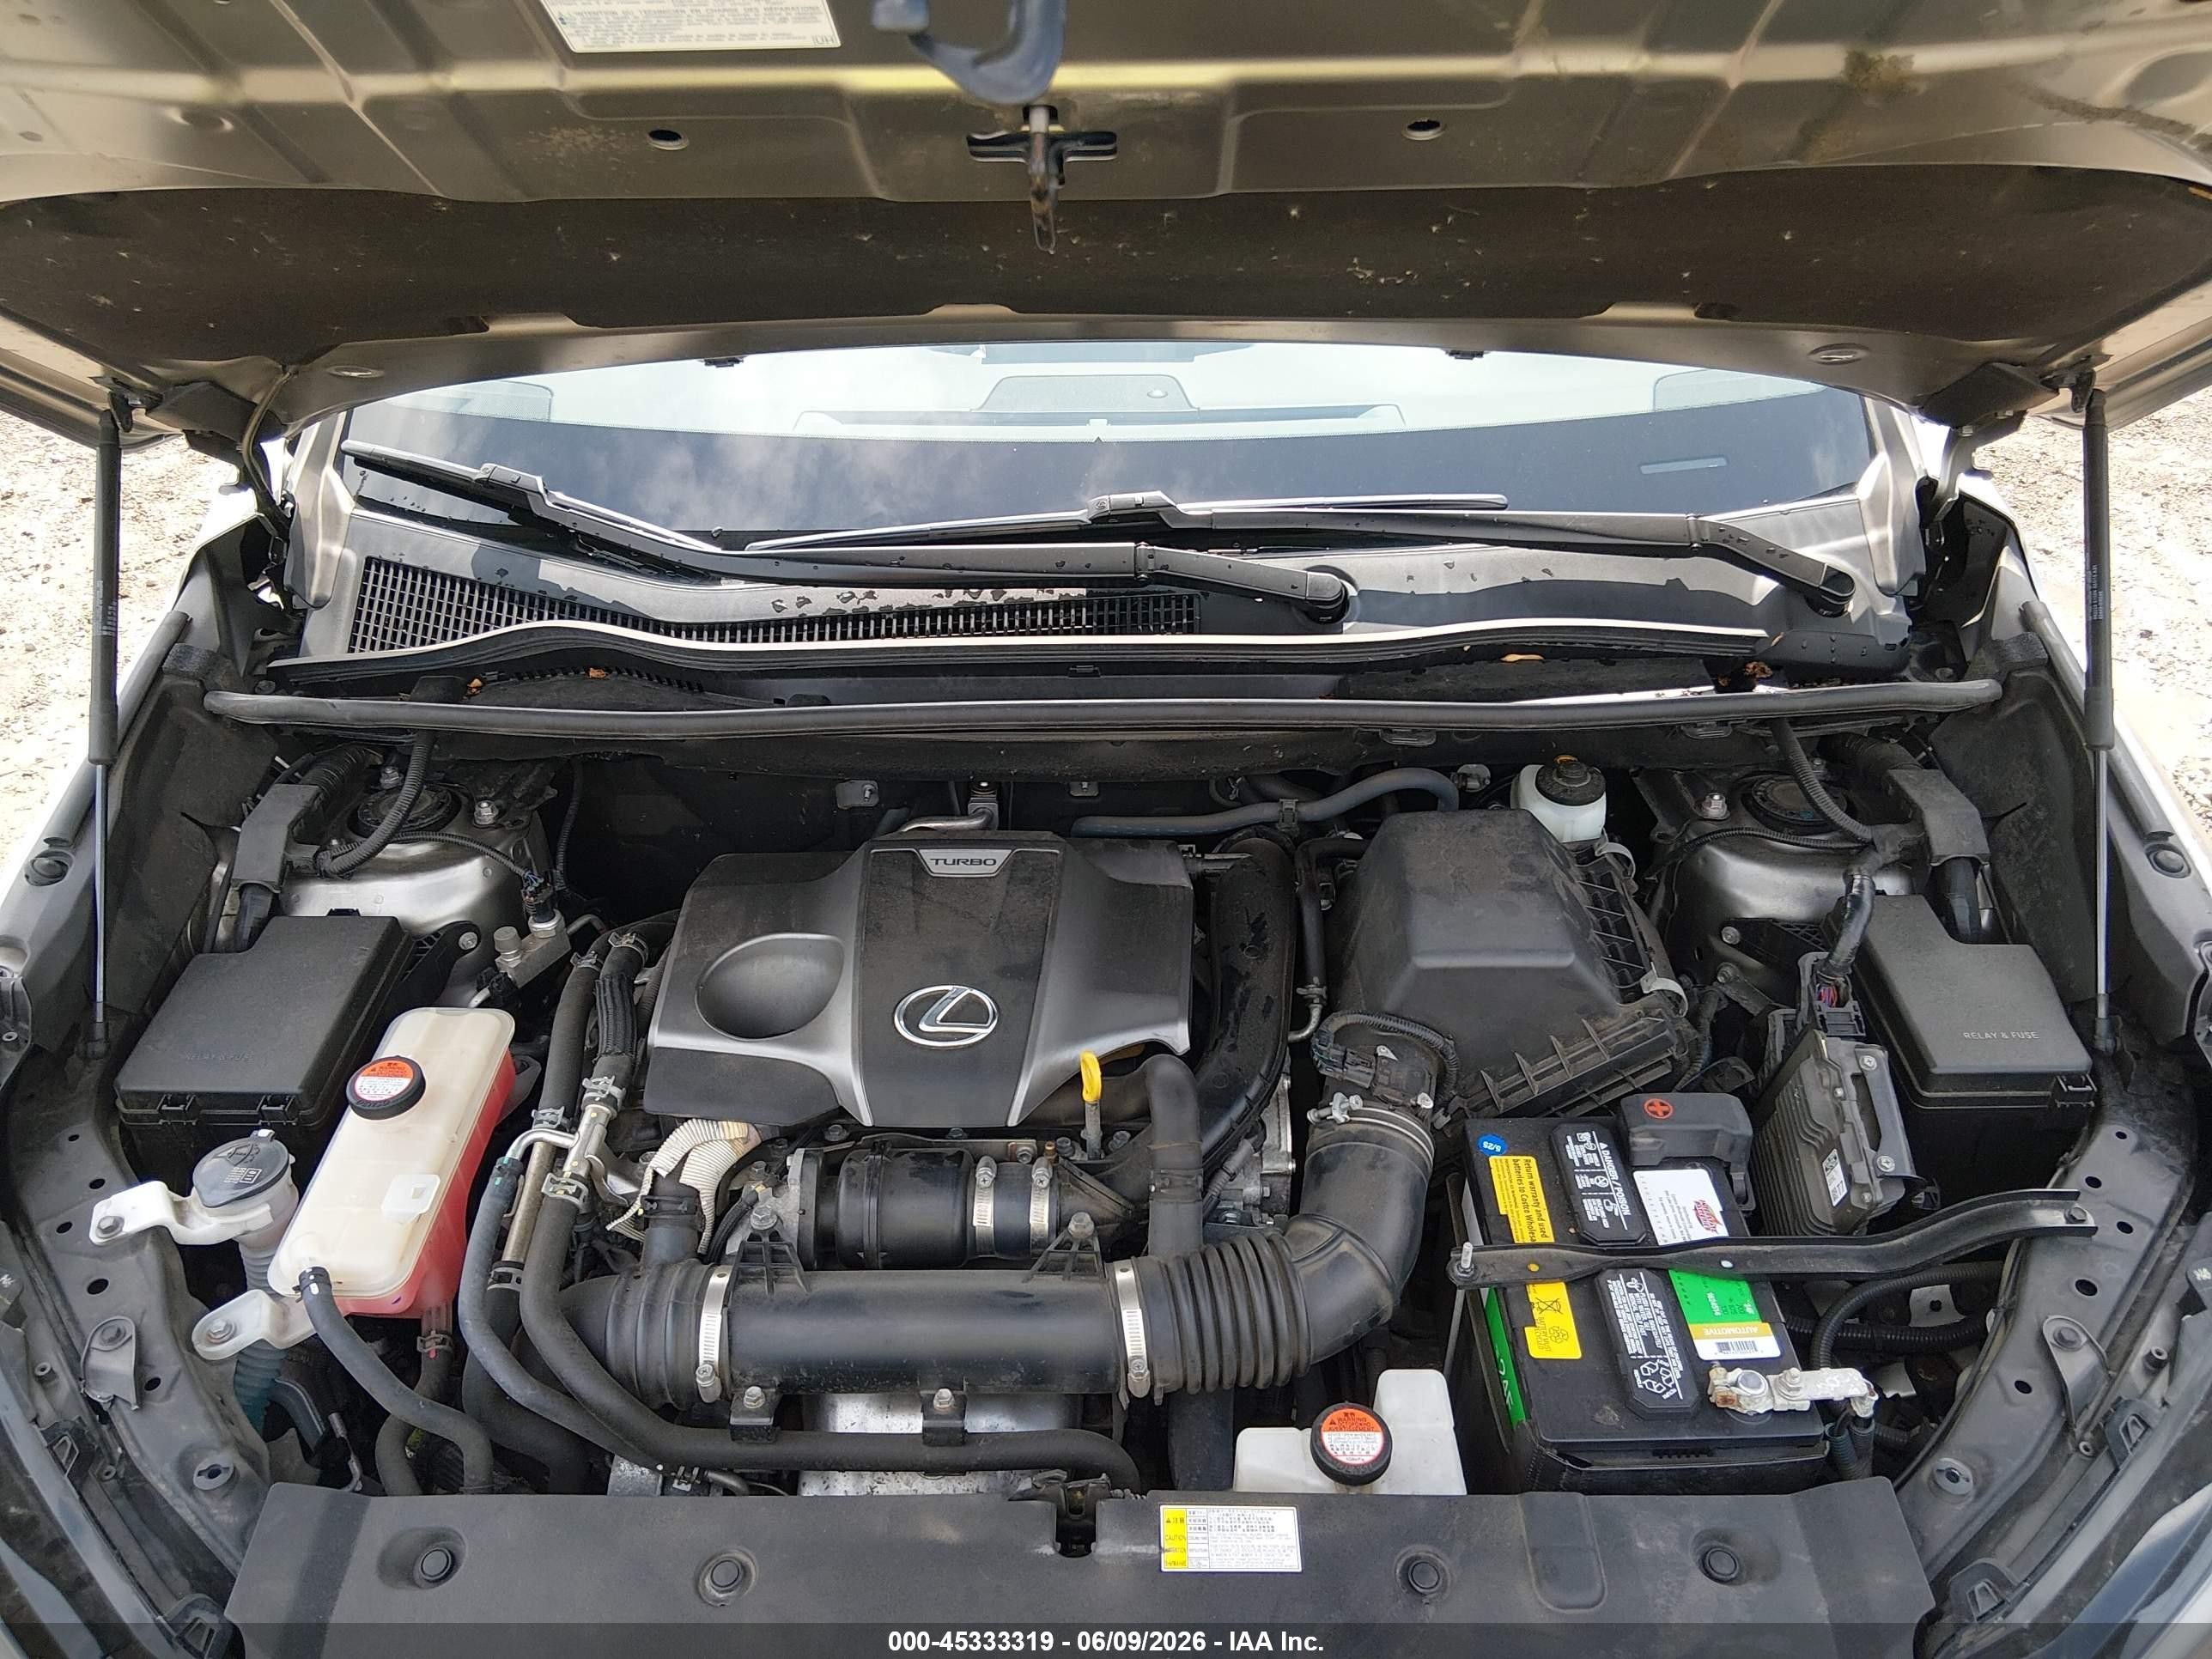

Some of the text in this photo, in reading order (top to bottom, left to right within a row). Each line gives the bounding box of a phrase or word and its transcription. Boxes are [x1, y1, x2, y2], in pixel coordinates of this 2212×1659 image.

[930, 858, 997, 866] TURBO
[1963, 1031, 2040, 1040] RELAY & FUSE
[1512, 1159, 1524, 1185] batteries
[1601, 1151, 1619, 1180] DANGER
[1614, 1187, 1632, 1215] POISON
[1524, 1159, 1550, 1238] Return warranty and used
[1703, 1326, 1759, 1335] AUTOMOTIVE
